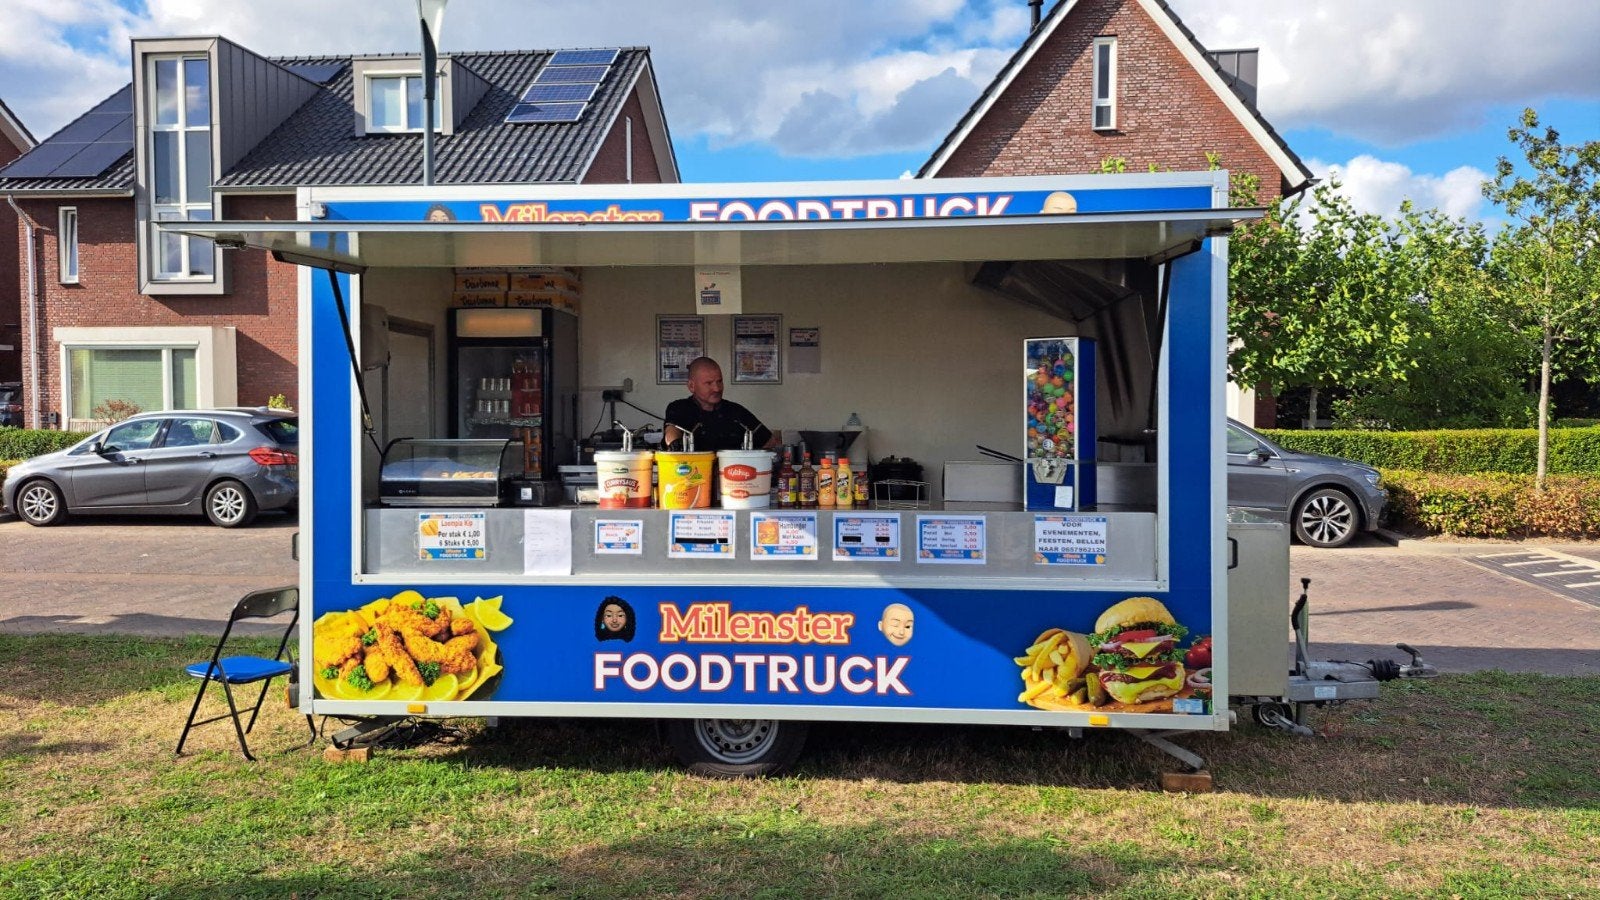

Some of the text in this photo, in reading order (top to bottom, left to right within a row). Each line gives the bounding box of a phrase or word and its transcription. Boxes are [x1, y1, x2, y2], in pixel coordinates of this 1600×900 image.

[438, 530, 448, 538] Per
[449, 530, 461, 538] stuk
[468, 530, 481, 539] 1,00
[1042, 529, 1101, 537] EVENEMENTEN,
[659, 602, 854, 644] Milenster
[594, 653, 911, 695] FOODTRUCK
